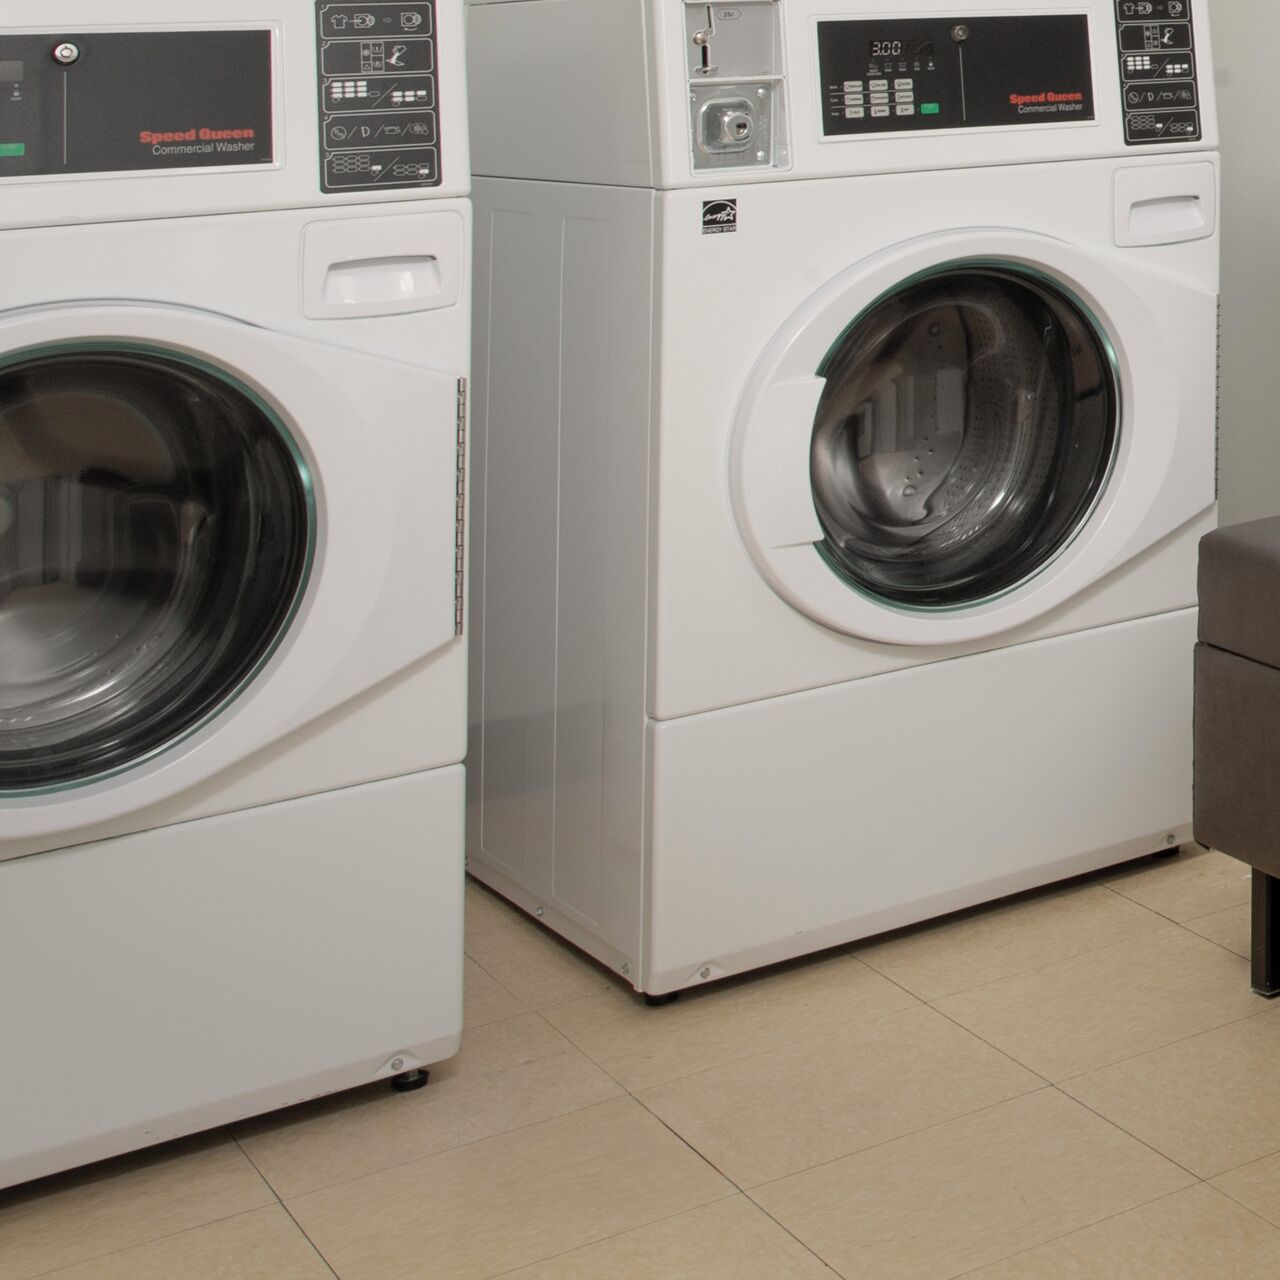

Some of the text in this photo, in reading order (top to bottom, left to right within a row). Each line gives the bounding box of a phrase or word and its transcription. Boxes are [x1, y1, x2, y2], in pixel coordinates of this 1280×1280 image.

[872, 41, 901, 56] 3.00
[1010, 92, 1082, 104] Speed Queen
[1018, 103, 1083, 113] Commercial Washer
[140, 128, 254, 145] Speed Queen
[152, 141, 255, 156] Commercial Washer
